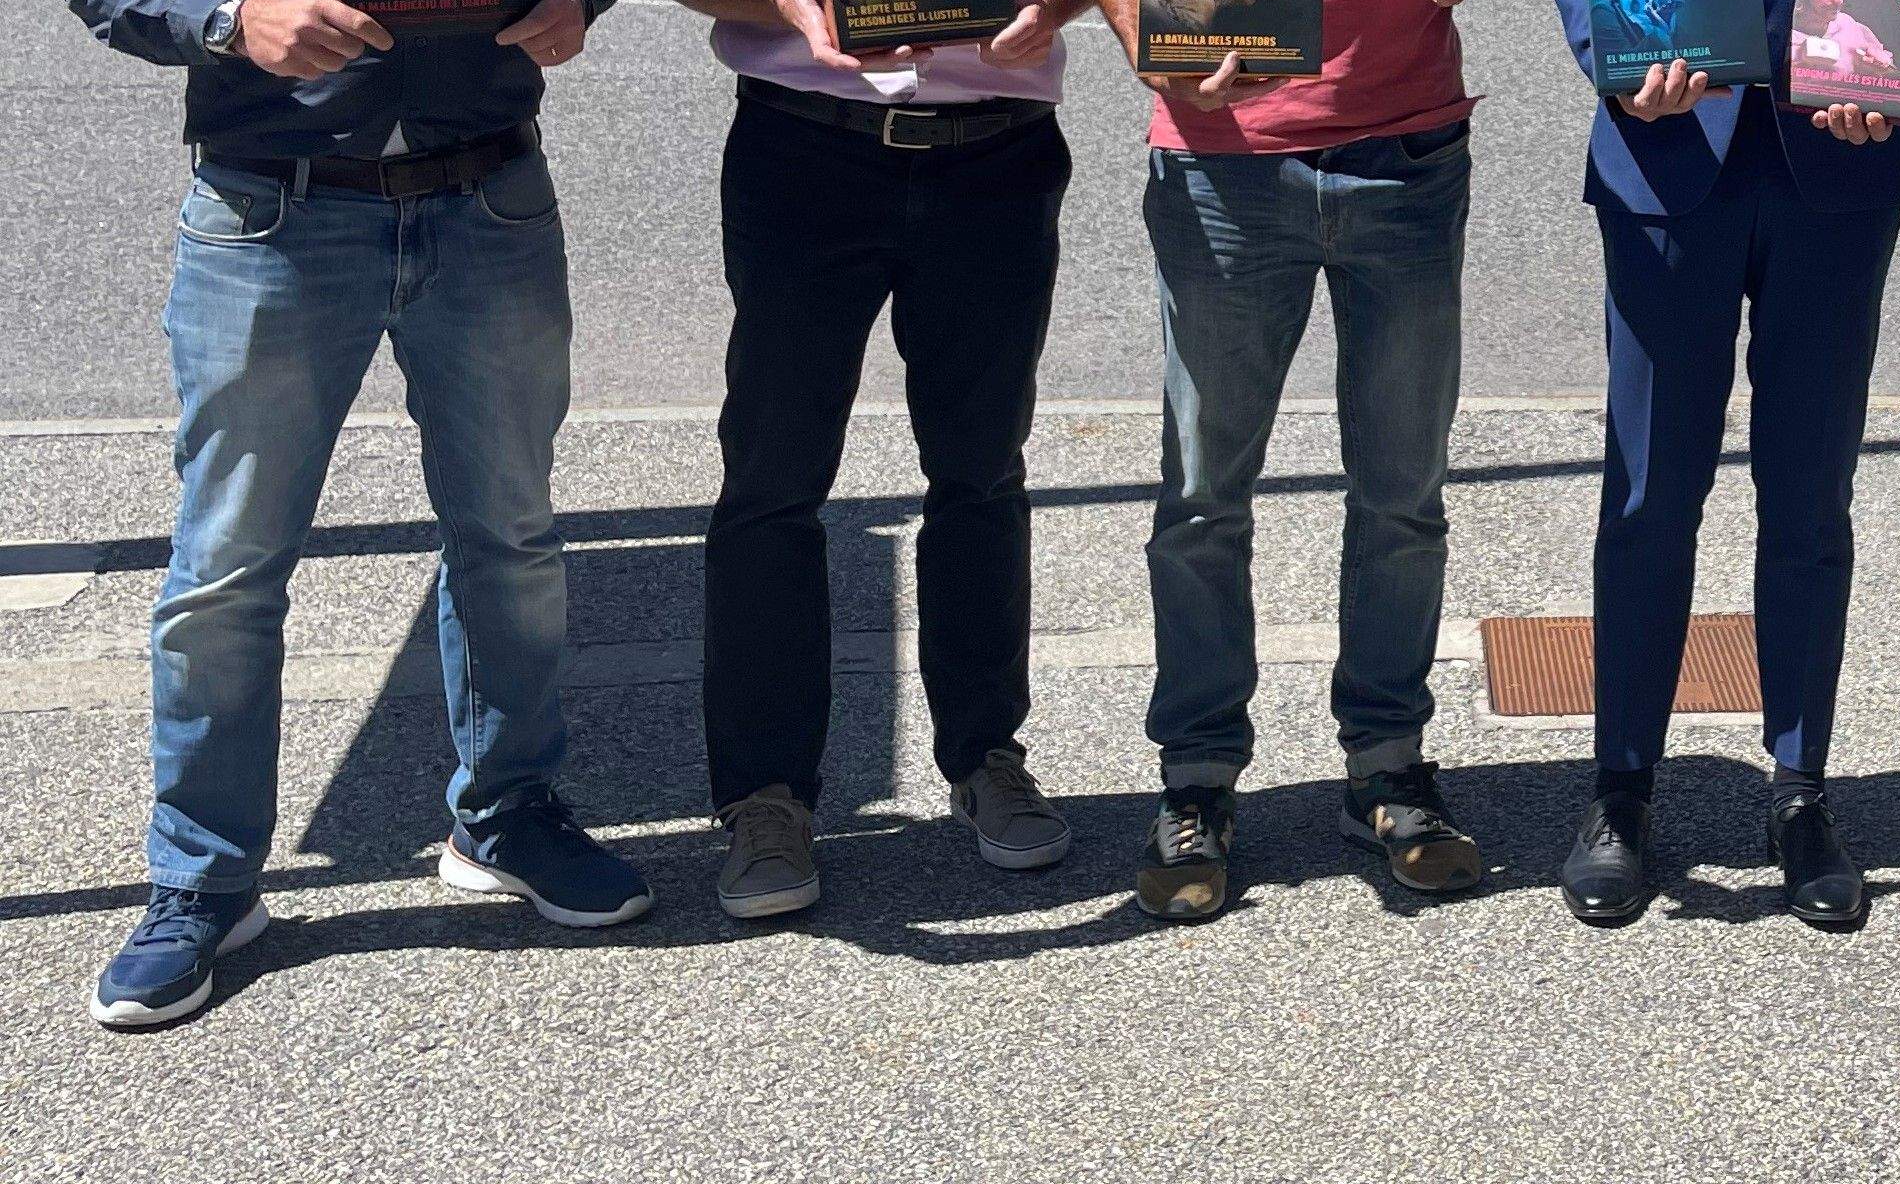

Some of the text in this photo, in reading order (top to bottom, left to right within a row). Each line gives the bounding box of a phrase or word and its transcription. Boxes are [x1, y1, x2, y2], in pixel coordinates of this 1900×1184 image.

[846, 1, 917, 16] EL REPTE DELS
[848, 13, 916, 28] PERSONATGES
[1149, 33, 1277, 47] LA BATALLA DELS PASTORS
[1606, 46, 1712, 64] EL MIRACLE DE L'AIGUA
